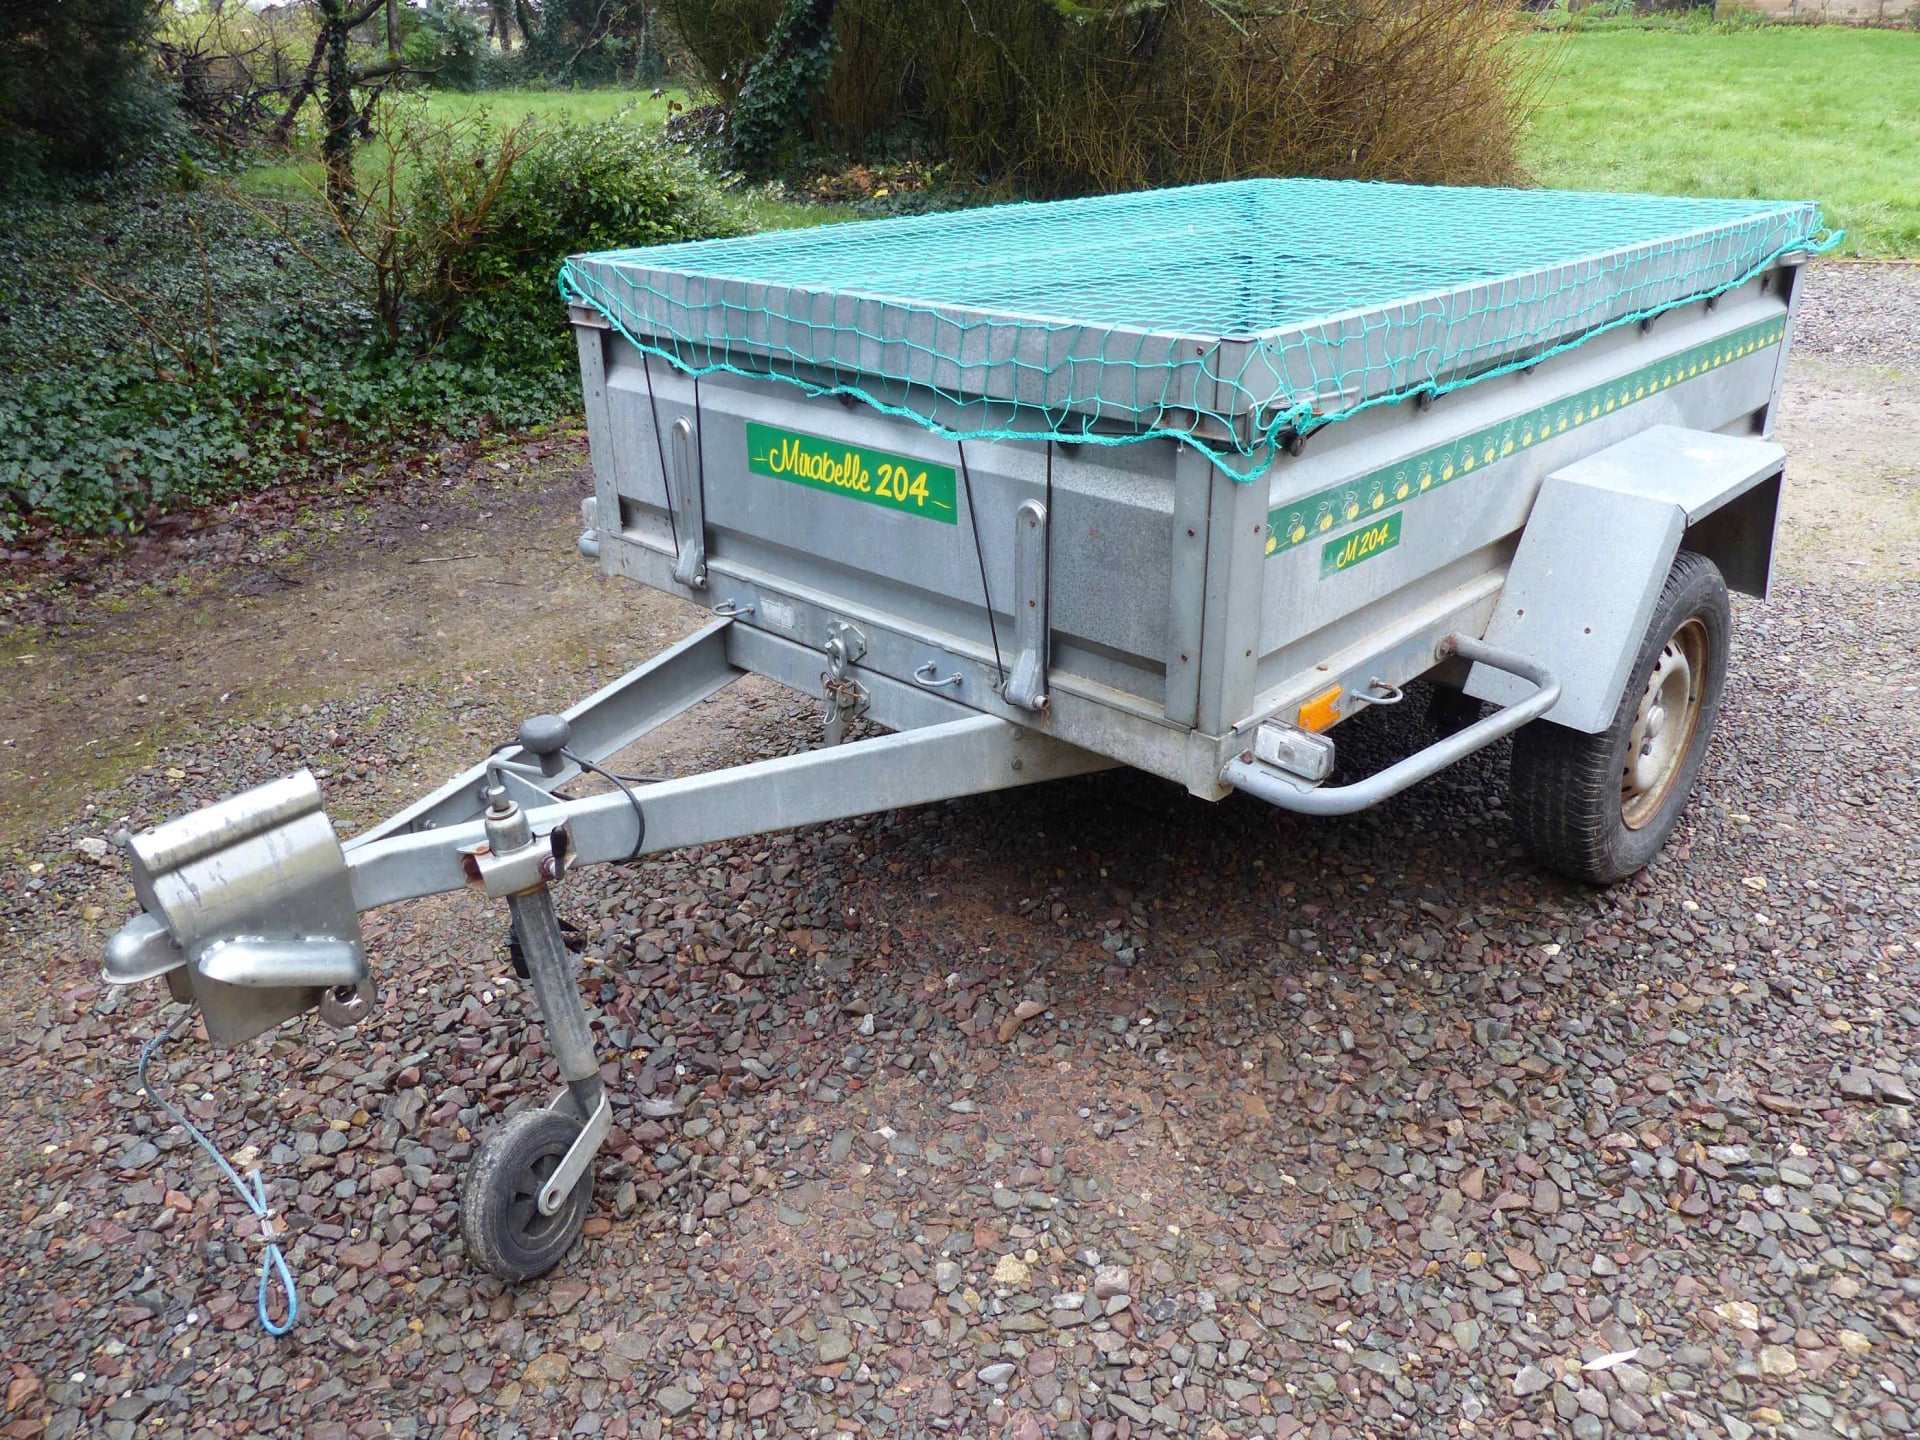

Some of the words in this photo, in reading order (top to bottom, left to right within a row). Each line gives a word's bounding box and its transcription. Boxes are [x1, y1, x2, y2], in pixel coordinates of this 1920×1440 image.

[769, 438, 871, 492] Mirabelle
[875, 464, 930, 507] 204
[1336, 535, 1358, 568] M
[1358, 523, 1389, 556] 204
